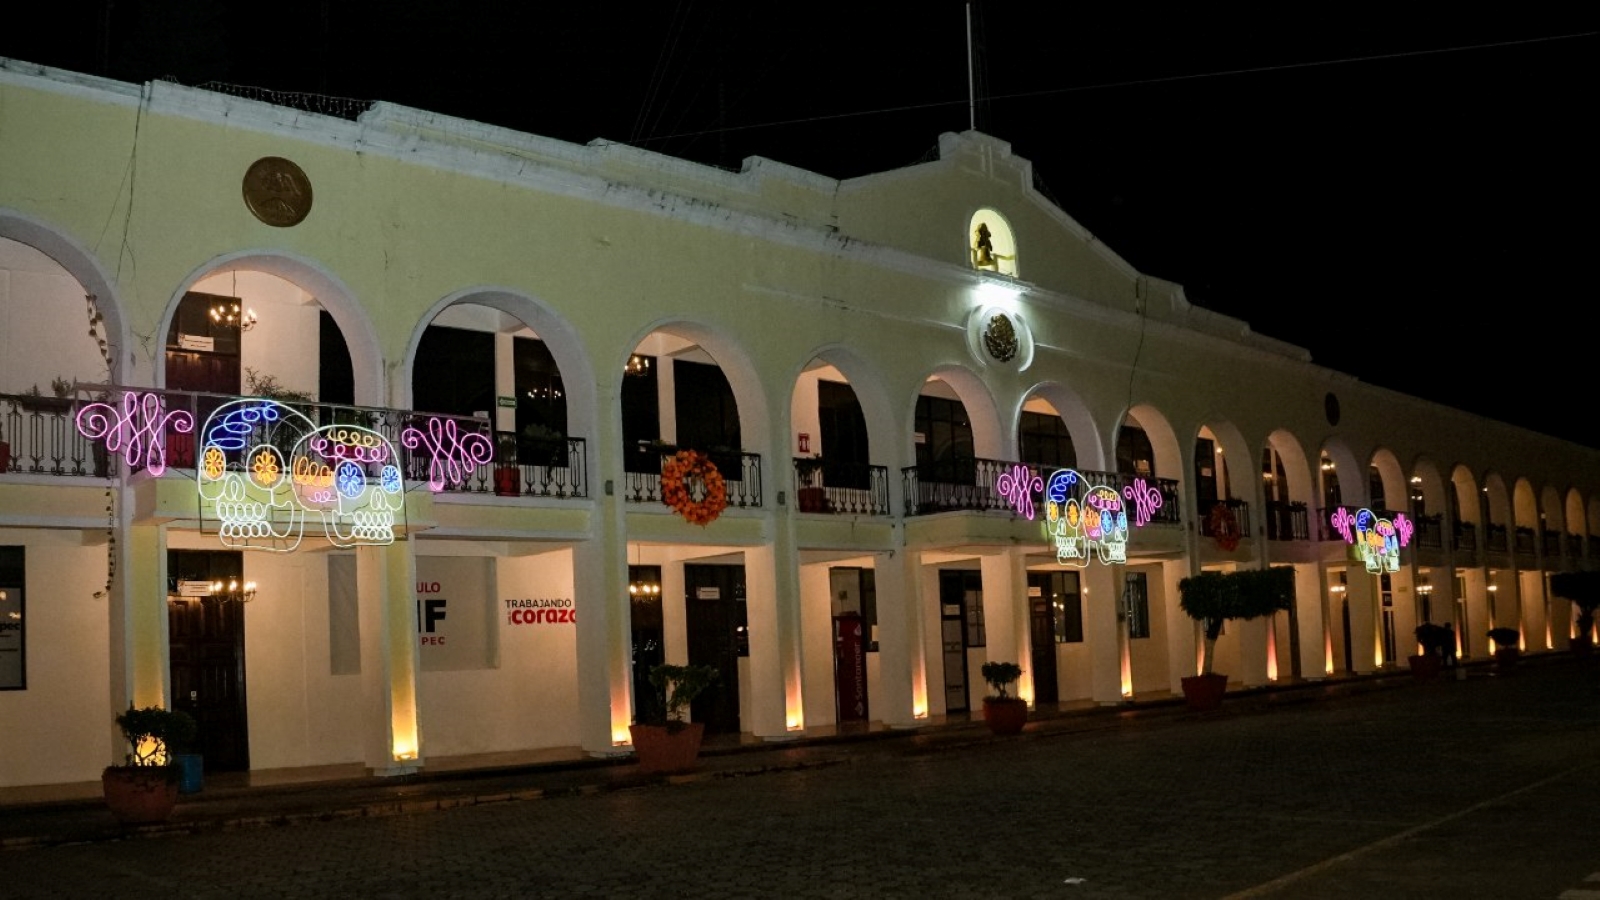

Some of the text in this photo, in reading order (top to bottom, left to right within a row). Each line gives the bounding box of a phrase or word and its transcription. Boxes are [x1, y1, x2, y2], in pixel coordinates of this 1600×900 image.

[505, 599, 572, 608] TRABAJANDO
[421, 637, 446, 646] PEC
[854, 642, 863, 701] Santander
